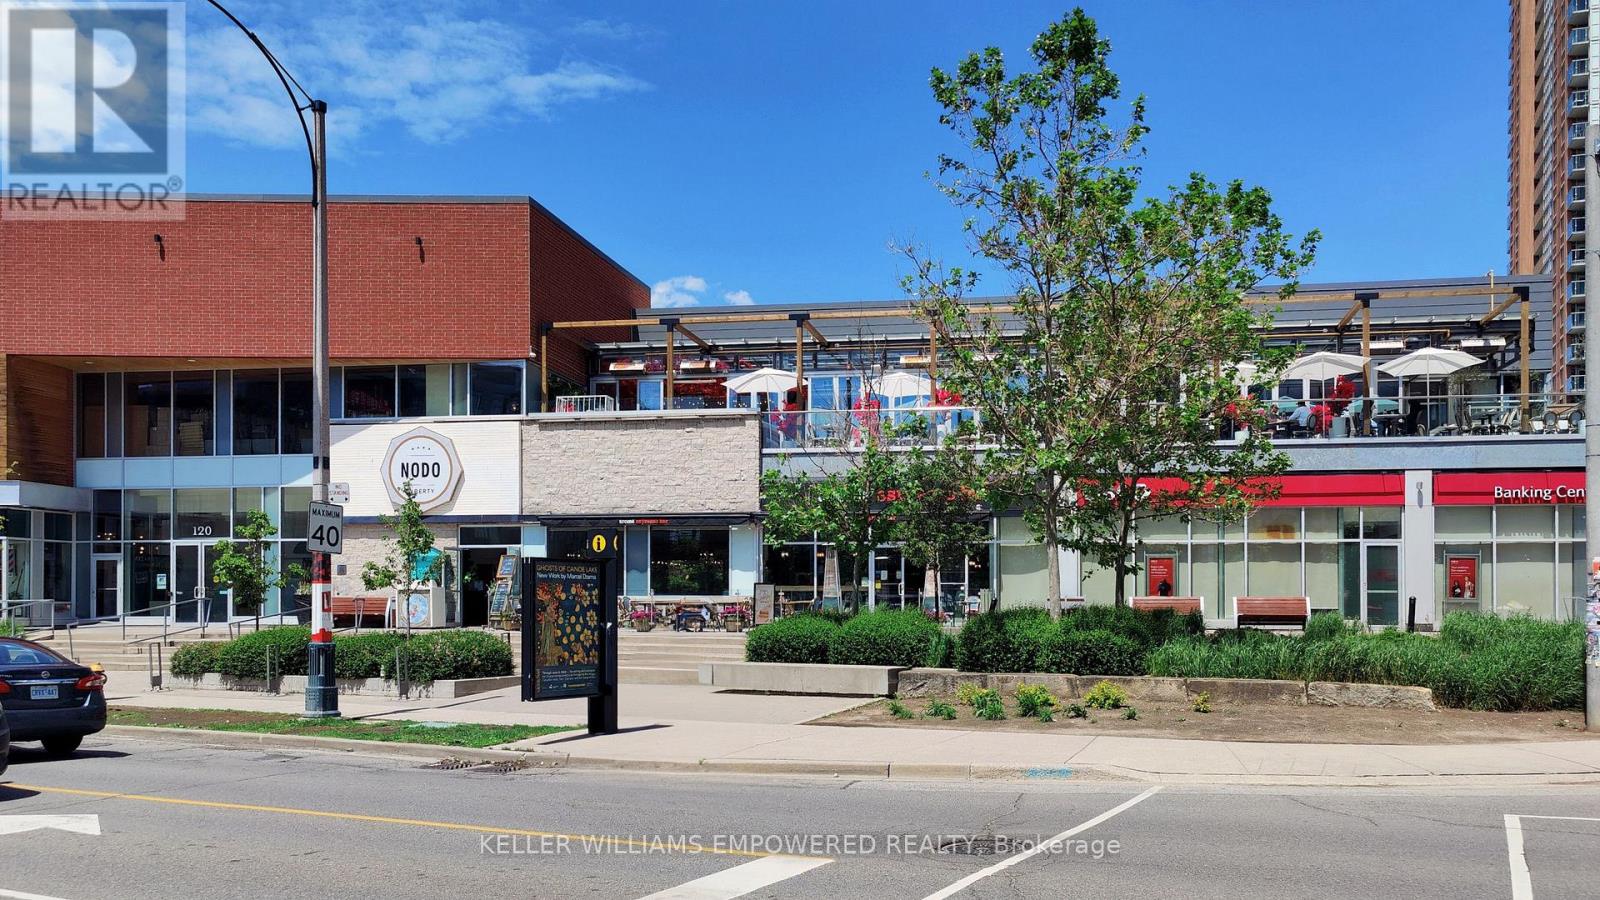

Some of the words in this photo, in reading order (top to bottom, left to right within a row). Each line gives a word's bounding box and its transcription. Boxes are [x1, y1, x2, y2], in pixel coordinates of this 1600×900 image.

[400, 462, 441, 478] NODO
[1494, 485, 1552, 501] Banking
[1556, 485, 1586, 498] Cen
[311, 507, 341, 518] MAXIMUM
[192, 525, 212, 536] 120
[311, 524, 339, 547] 40
